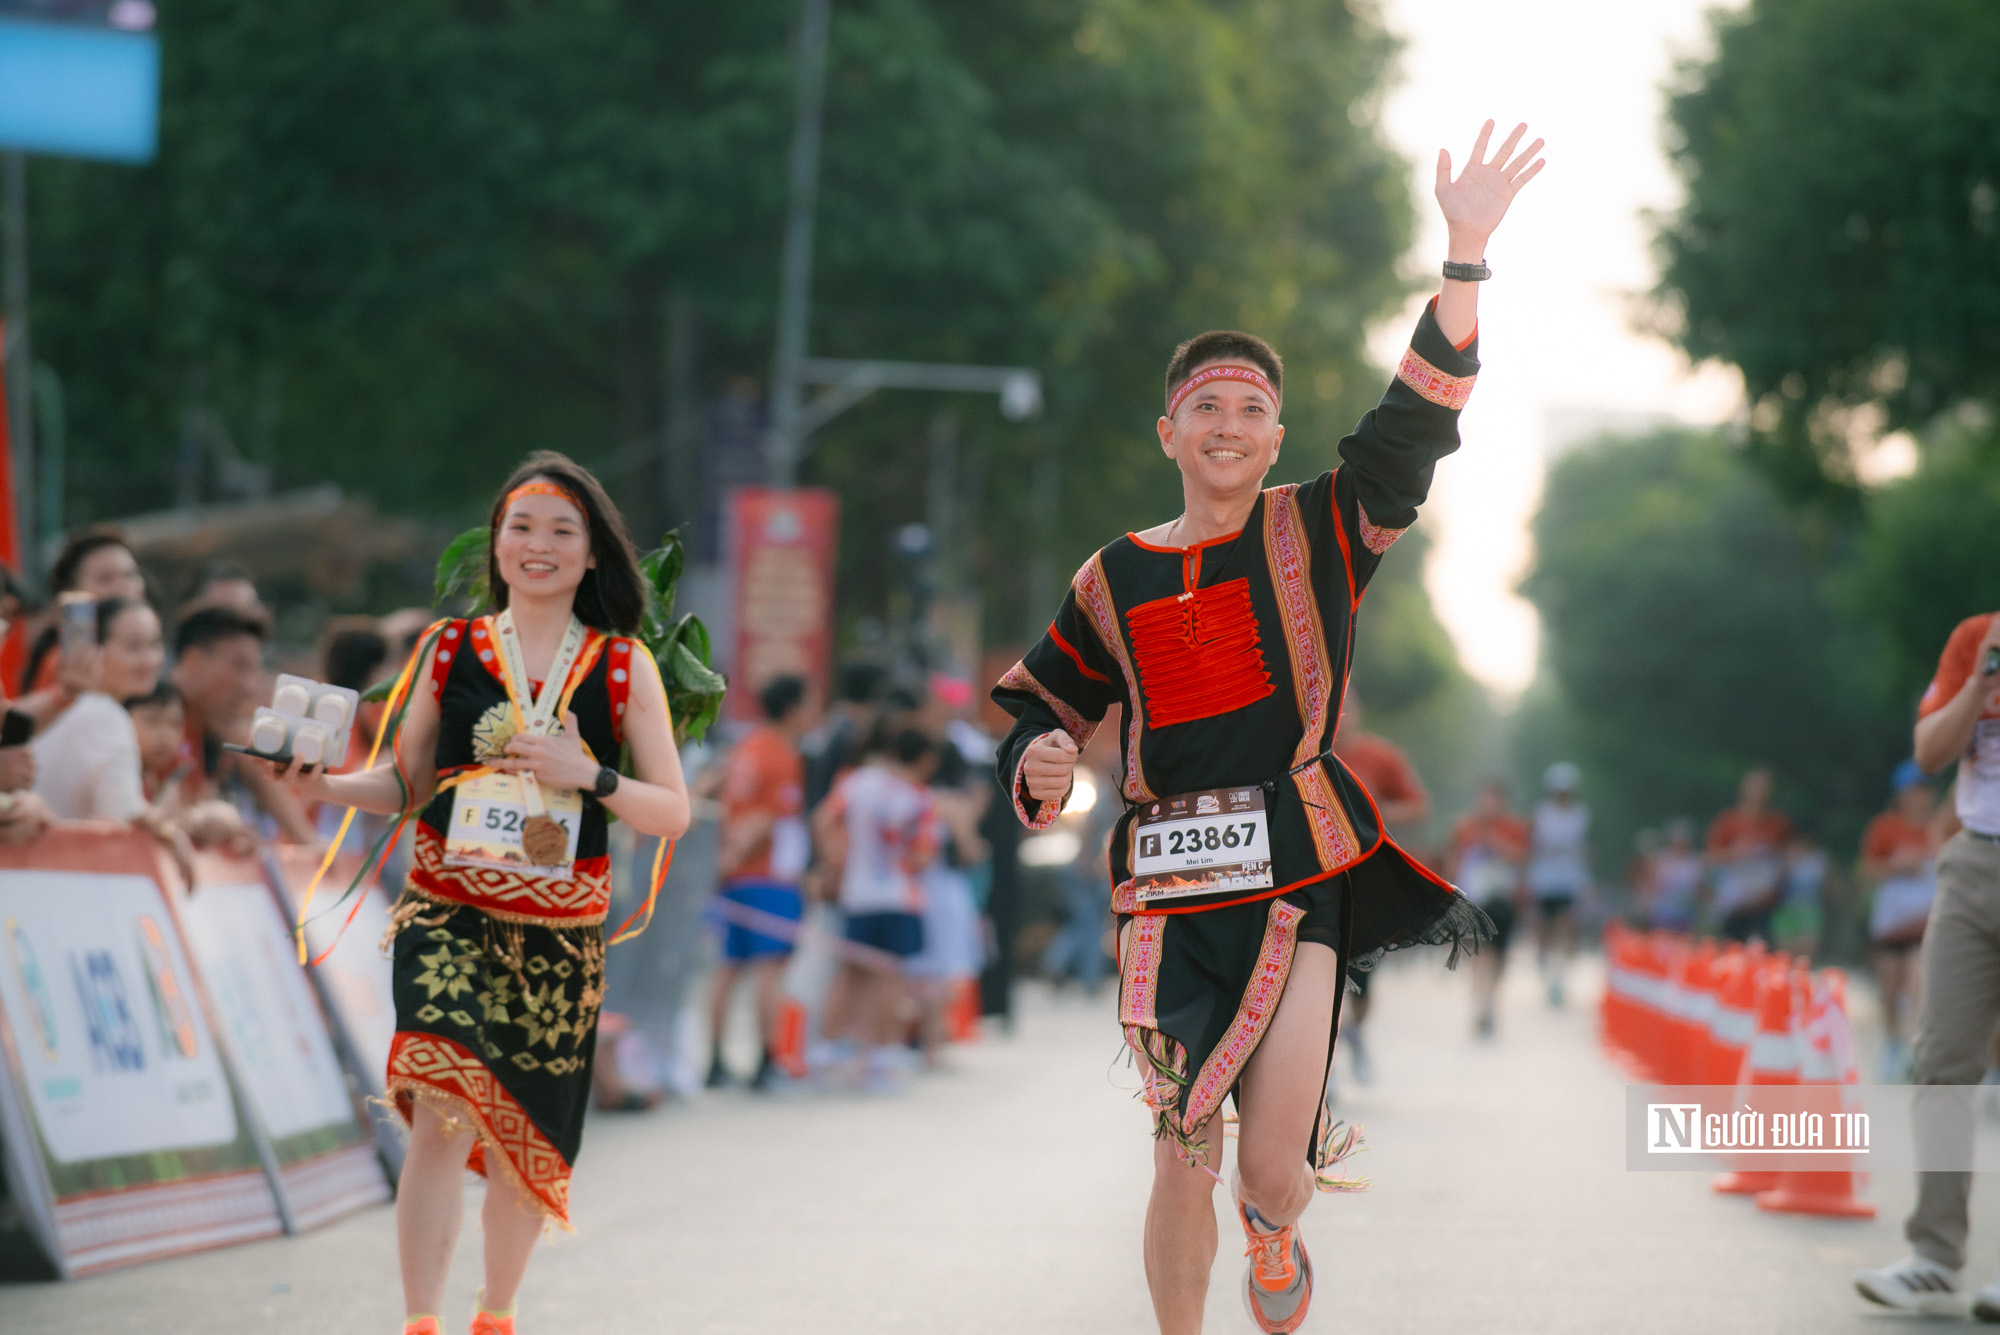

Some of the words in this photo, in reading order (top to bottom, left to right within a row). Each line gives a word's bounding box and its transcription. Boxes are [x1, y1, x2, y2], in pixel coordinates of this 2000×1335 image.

[1146, 837, 1154, 855] F
[1168, 822, 1256, 855] 23867
[1242, 862, 1257, 871] PEN
[1258, 861, 1264, 870] C
[1145, 888, 1165, 898] 21KM
